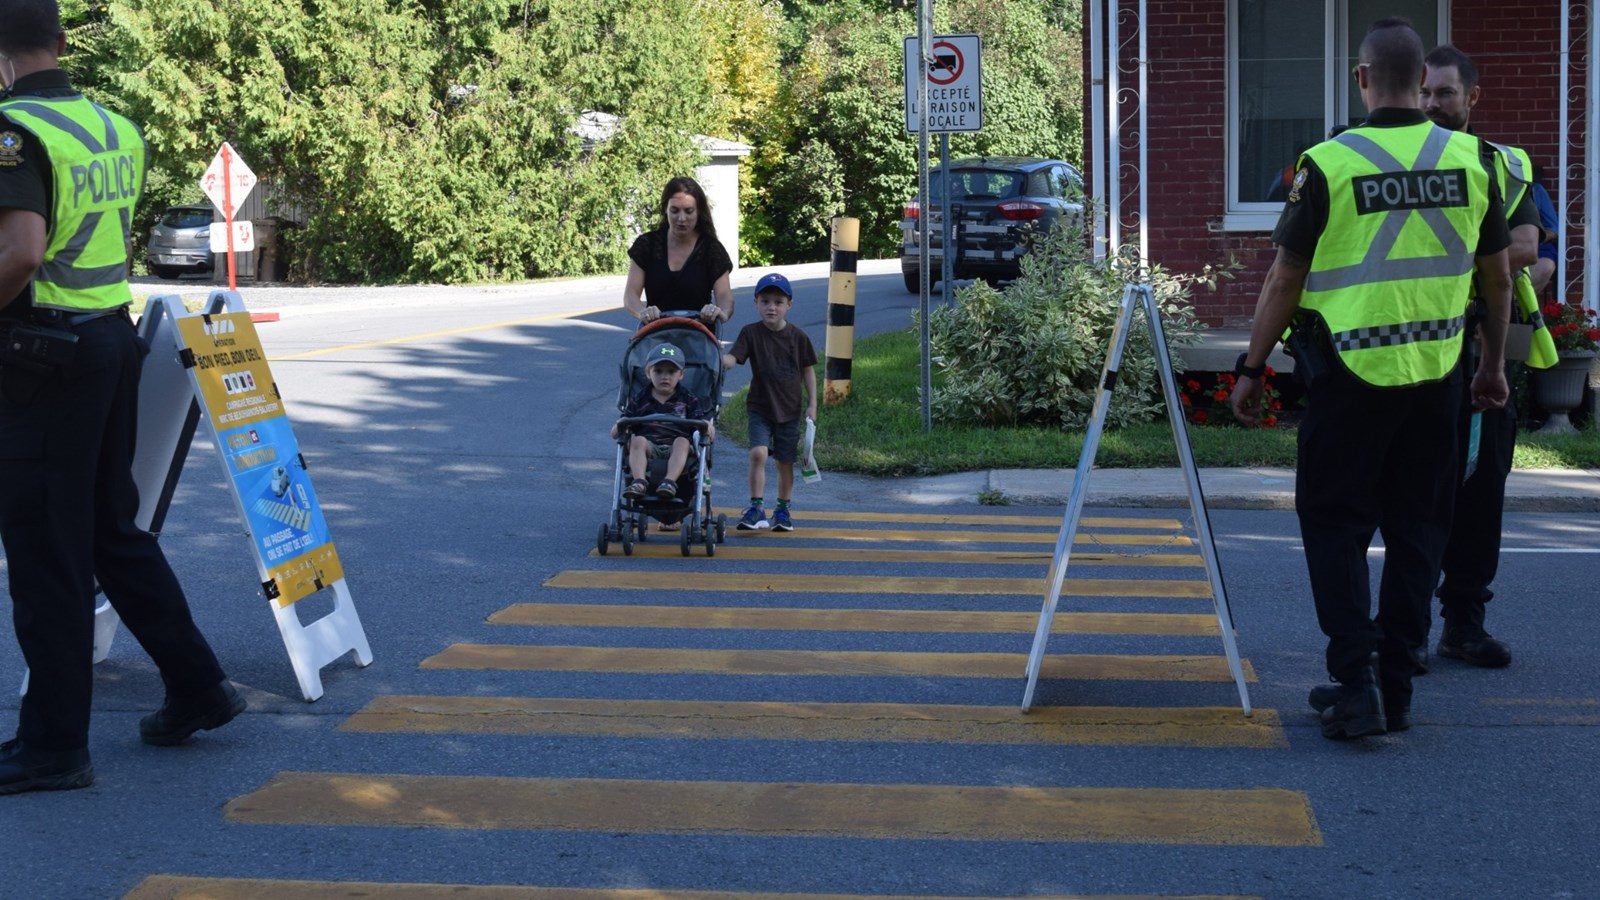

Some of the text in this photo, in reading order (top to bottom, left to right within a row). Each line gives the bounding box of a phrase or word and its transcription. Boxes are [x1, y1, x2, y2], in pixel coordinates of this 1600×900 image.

[917, 86, 970, 100] XCEPTÉ
[912, 102, 975, 114] LRAISON
[928, 115, 965, 127] OCALE
[71, 155, 135, 209] POLICE
[1362, 173, 1460, 208] POLICE
[198, 355, 214, 369] BON
[231, 351, 246, 364] BON
[263, 536, 272, 548] AU
[267, 549, 277, 560] ON
[275, 546, 284, 557] SE
[282, 542, 294, 554] FAIT
[292, 539, 302, 550] DE
